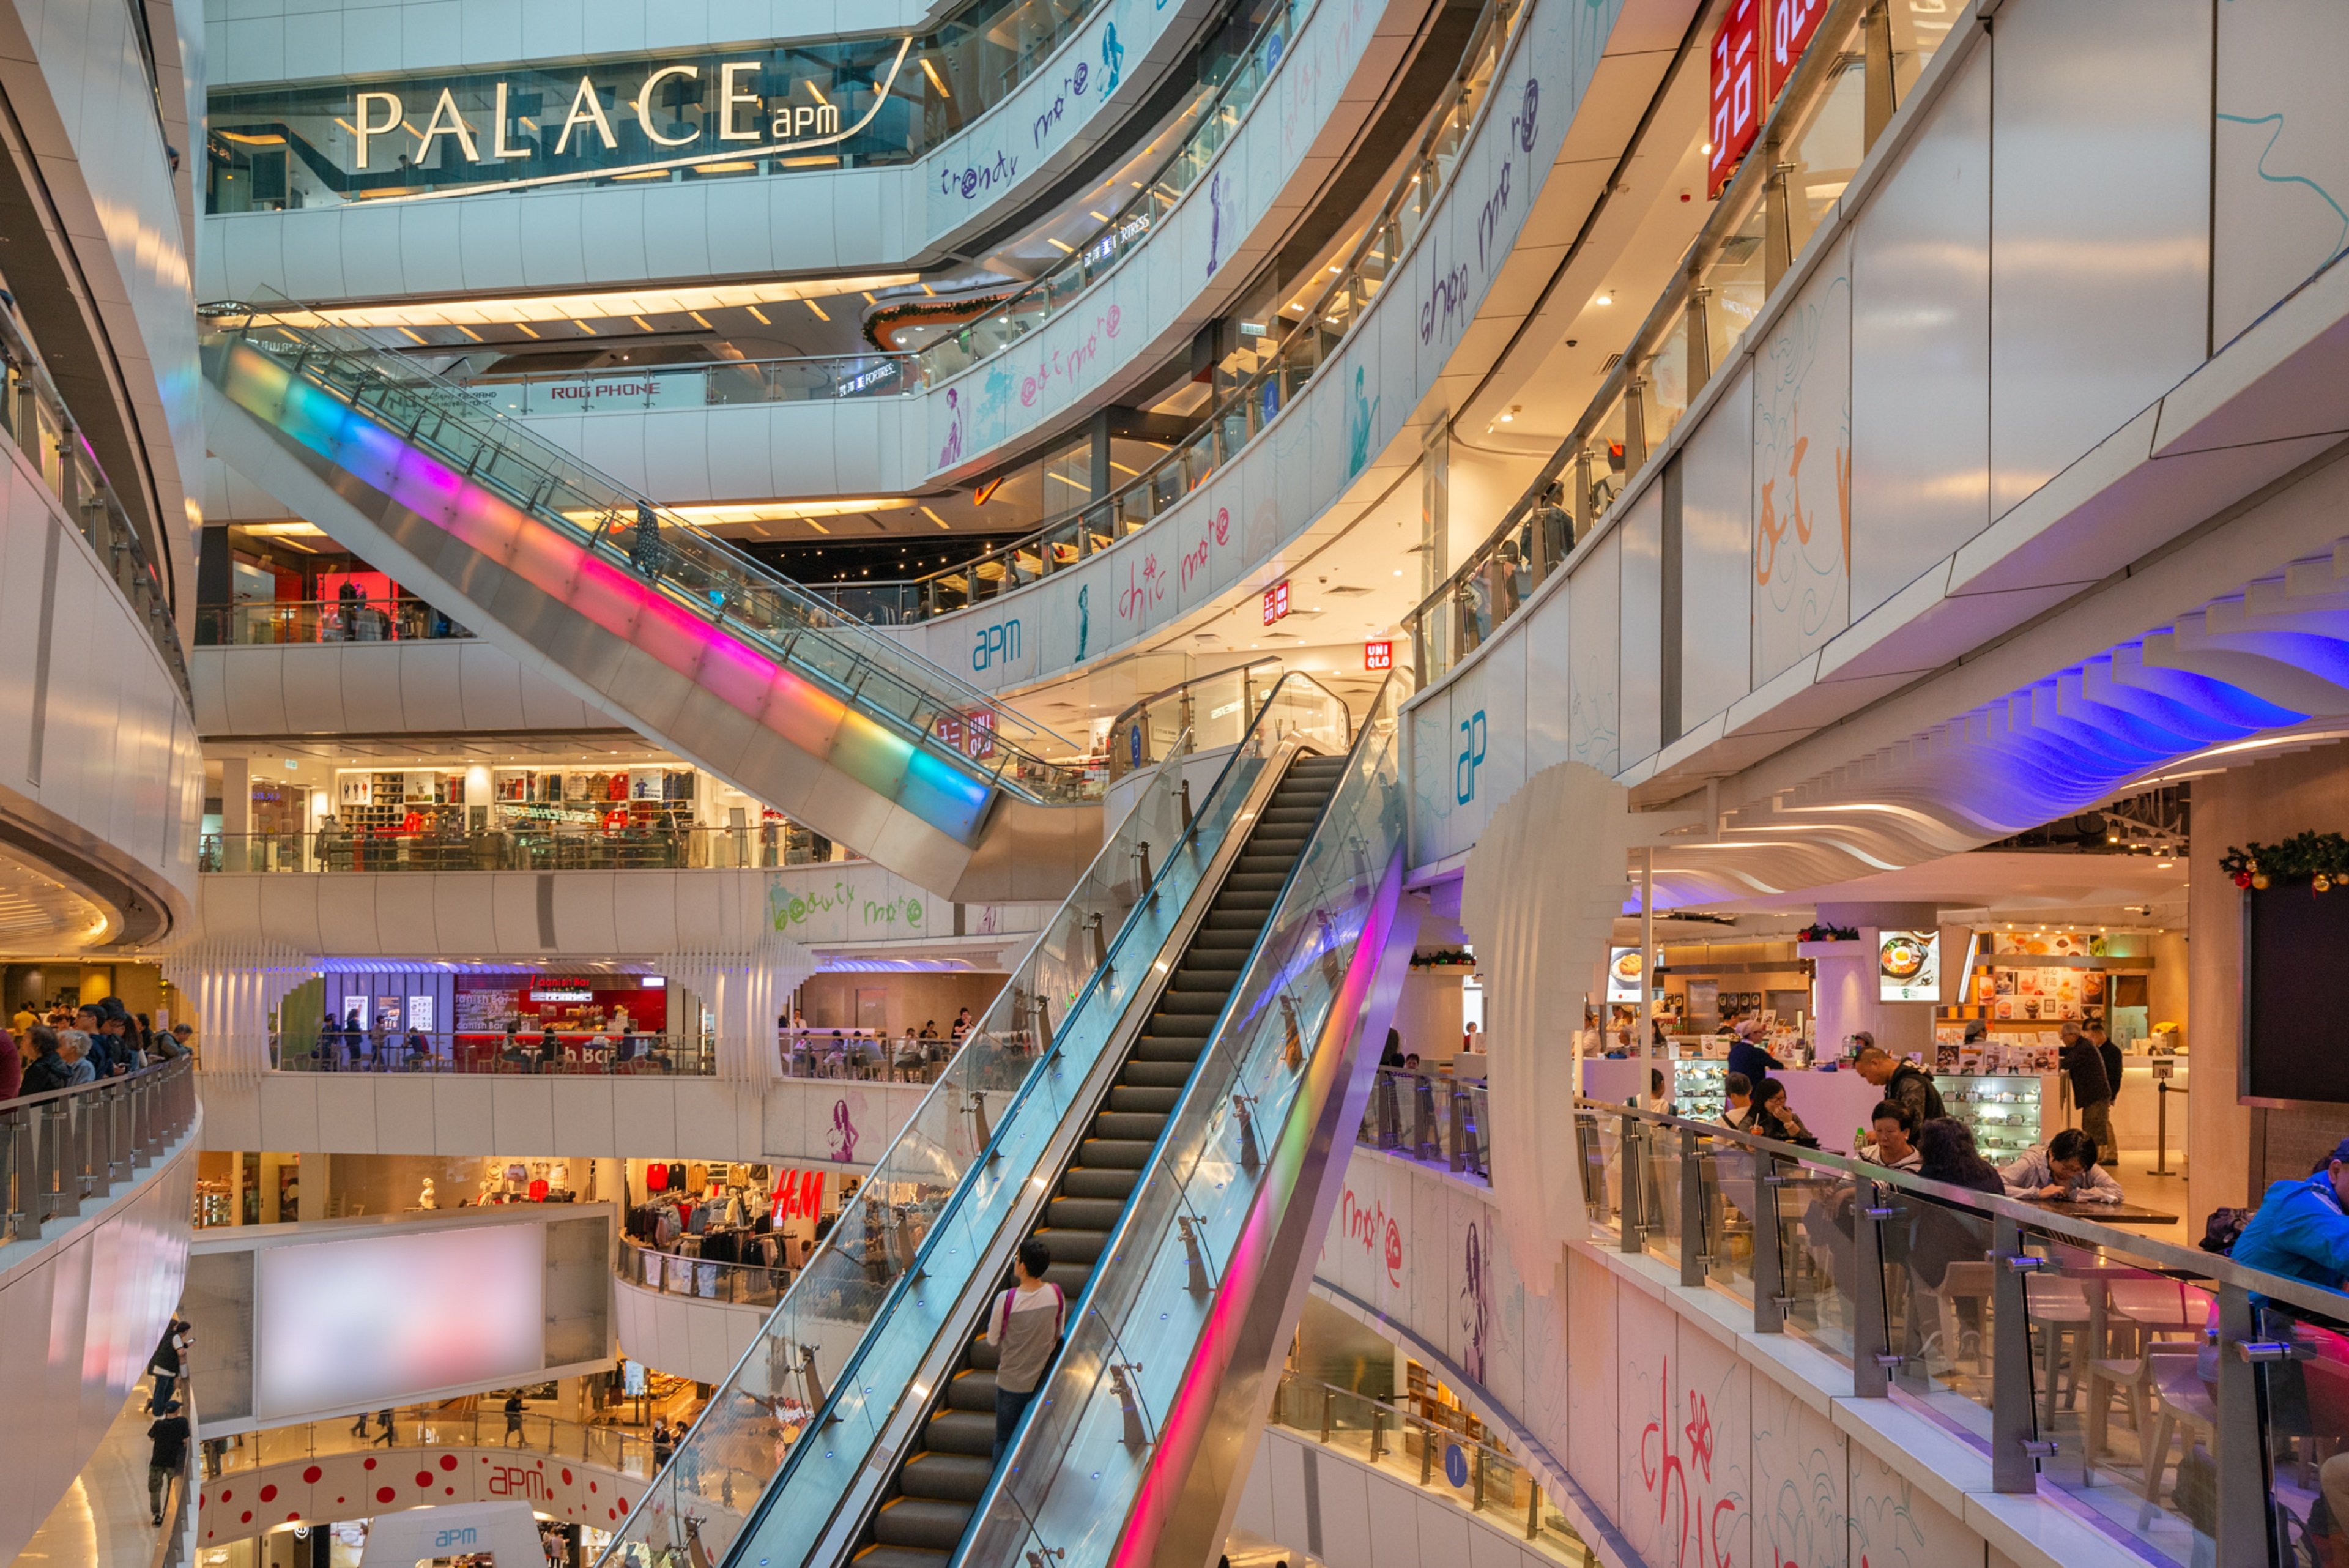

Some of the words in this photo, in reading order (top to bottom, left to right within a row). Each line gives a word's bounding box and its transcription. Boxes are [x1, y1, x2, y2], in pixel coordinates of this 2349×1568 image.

[1775, 0, 1816, 67] QL
[357, 62, 762, 169] PALACE
[596, 382, 661, 397] PHONE
[973, 619, 1020, 672] apm
[1367, 644, 1388, 656] UNI
[1367, 656, 1390, 669] QLO
[771, 1169, 825, 1224] H&M
[489, 1466, 545, 1501] apm
[435, 1527, 477, 1547] apm
